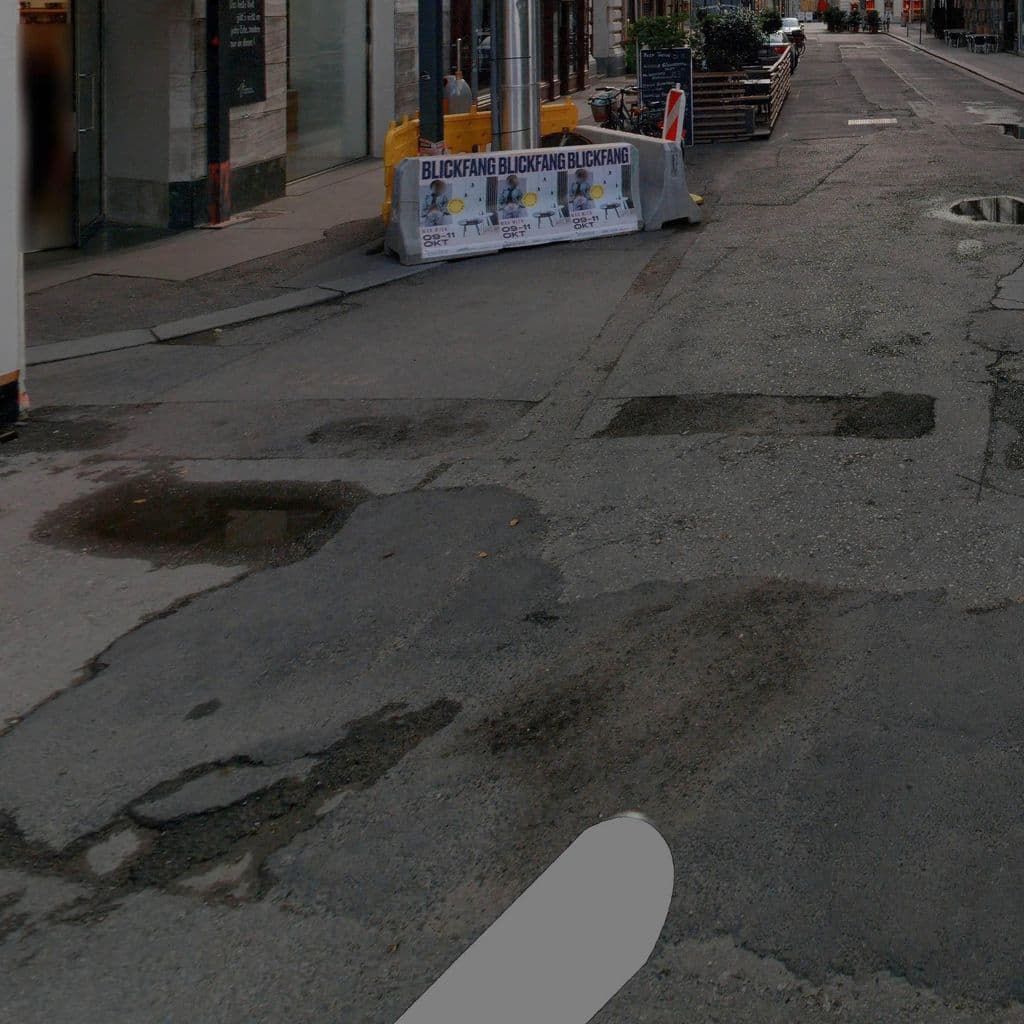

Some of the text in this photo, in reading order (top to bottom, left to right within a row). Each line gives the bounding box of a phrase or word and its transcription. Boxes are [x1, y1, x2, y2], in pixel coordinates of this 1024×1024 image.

[422, 147, 629, 180] BLICKFANG BLICKFANG BLICKFANG
[573, 222, 594, 230] OKT
[503, 231, 525, 239] OKT
[423, 239, 448, 248] OKT
